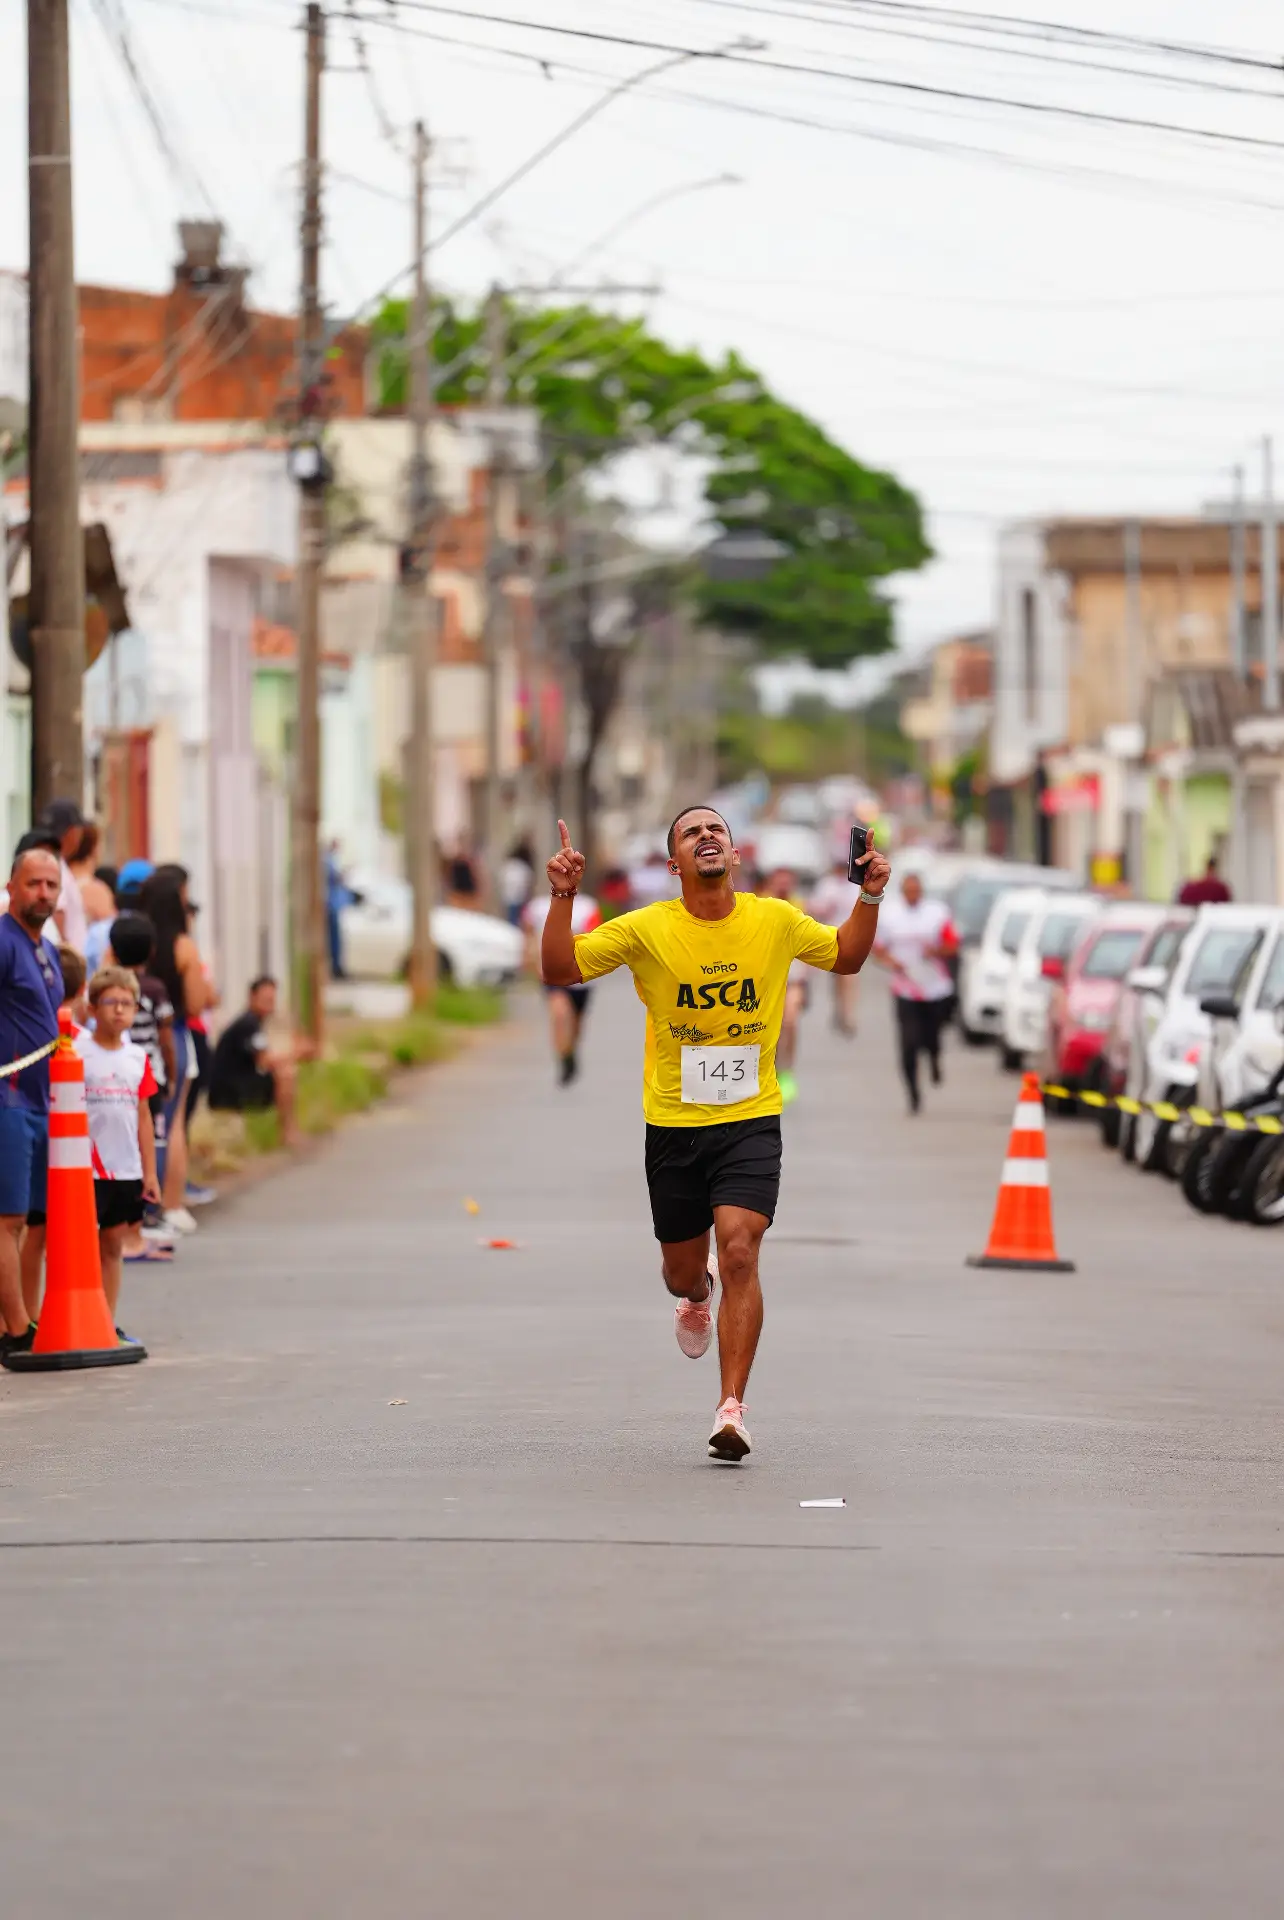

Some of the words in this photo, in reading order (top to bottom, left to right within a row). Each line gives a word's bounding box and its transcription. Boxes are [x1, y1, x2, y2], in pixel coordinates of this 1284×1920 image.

[700, 963, 737, 974] YoPRO
[676, 978, 756, 1009] ASCA
[736, 998, 761, 1014] RUN
[698, 1059, 745, 1081] 143
